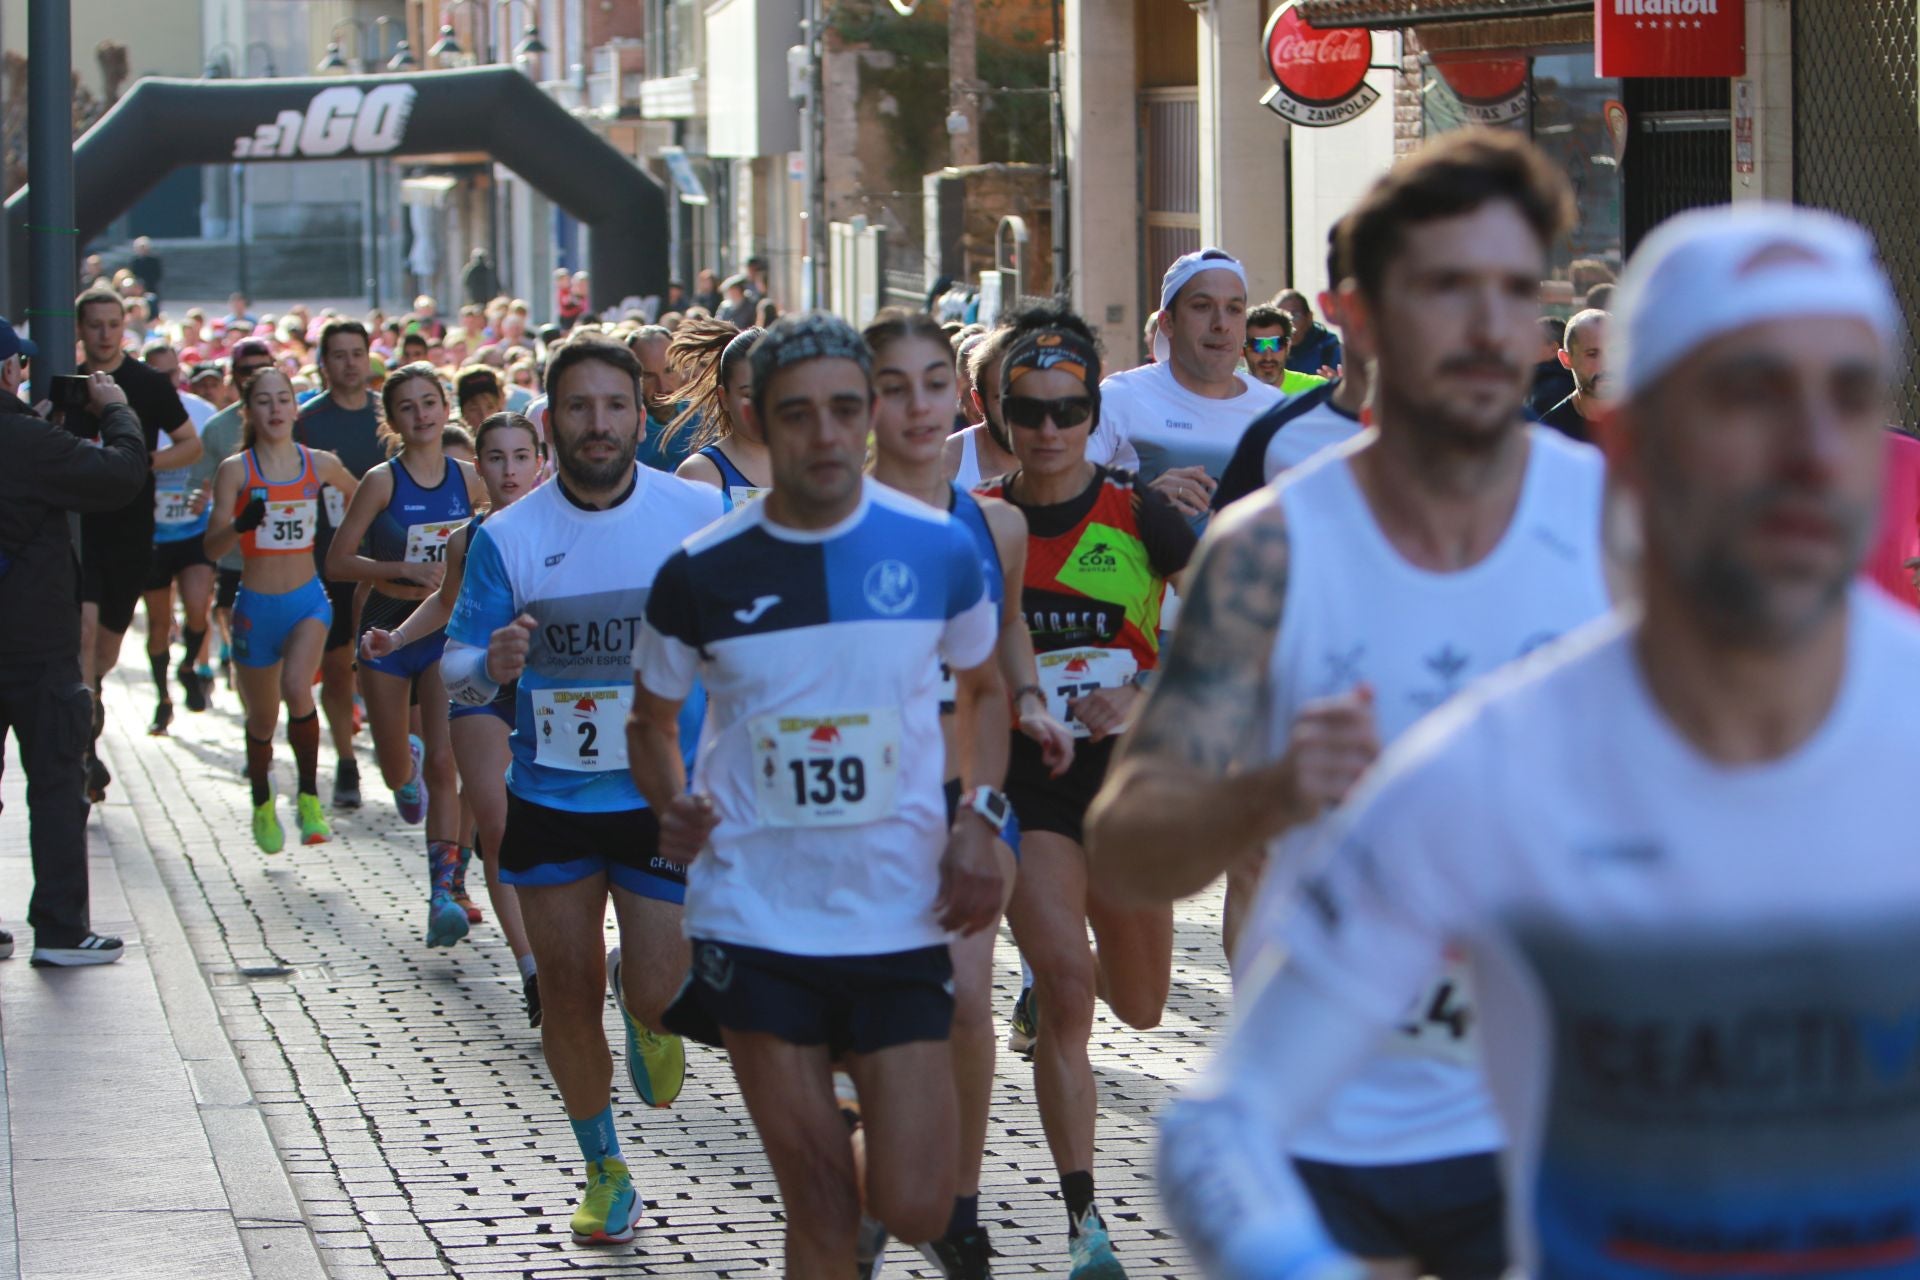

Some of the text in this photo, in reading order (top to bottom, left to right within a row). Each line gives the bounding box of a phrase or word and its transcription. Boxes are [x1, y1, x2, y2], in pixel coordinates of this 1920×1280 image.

[1308, 94, 1371, 121] ZAMPOLA
[273, 520, 304, 541] 315
[1078, 554, 1117, 566] coa
[578, 721, 599, 757] 2
[790, 757, 866, 806] 139
